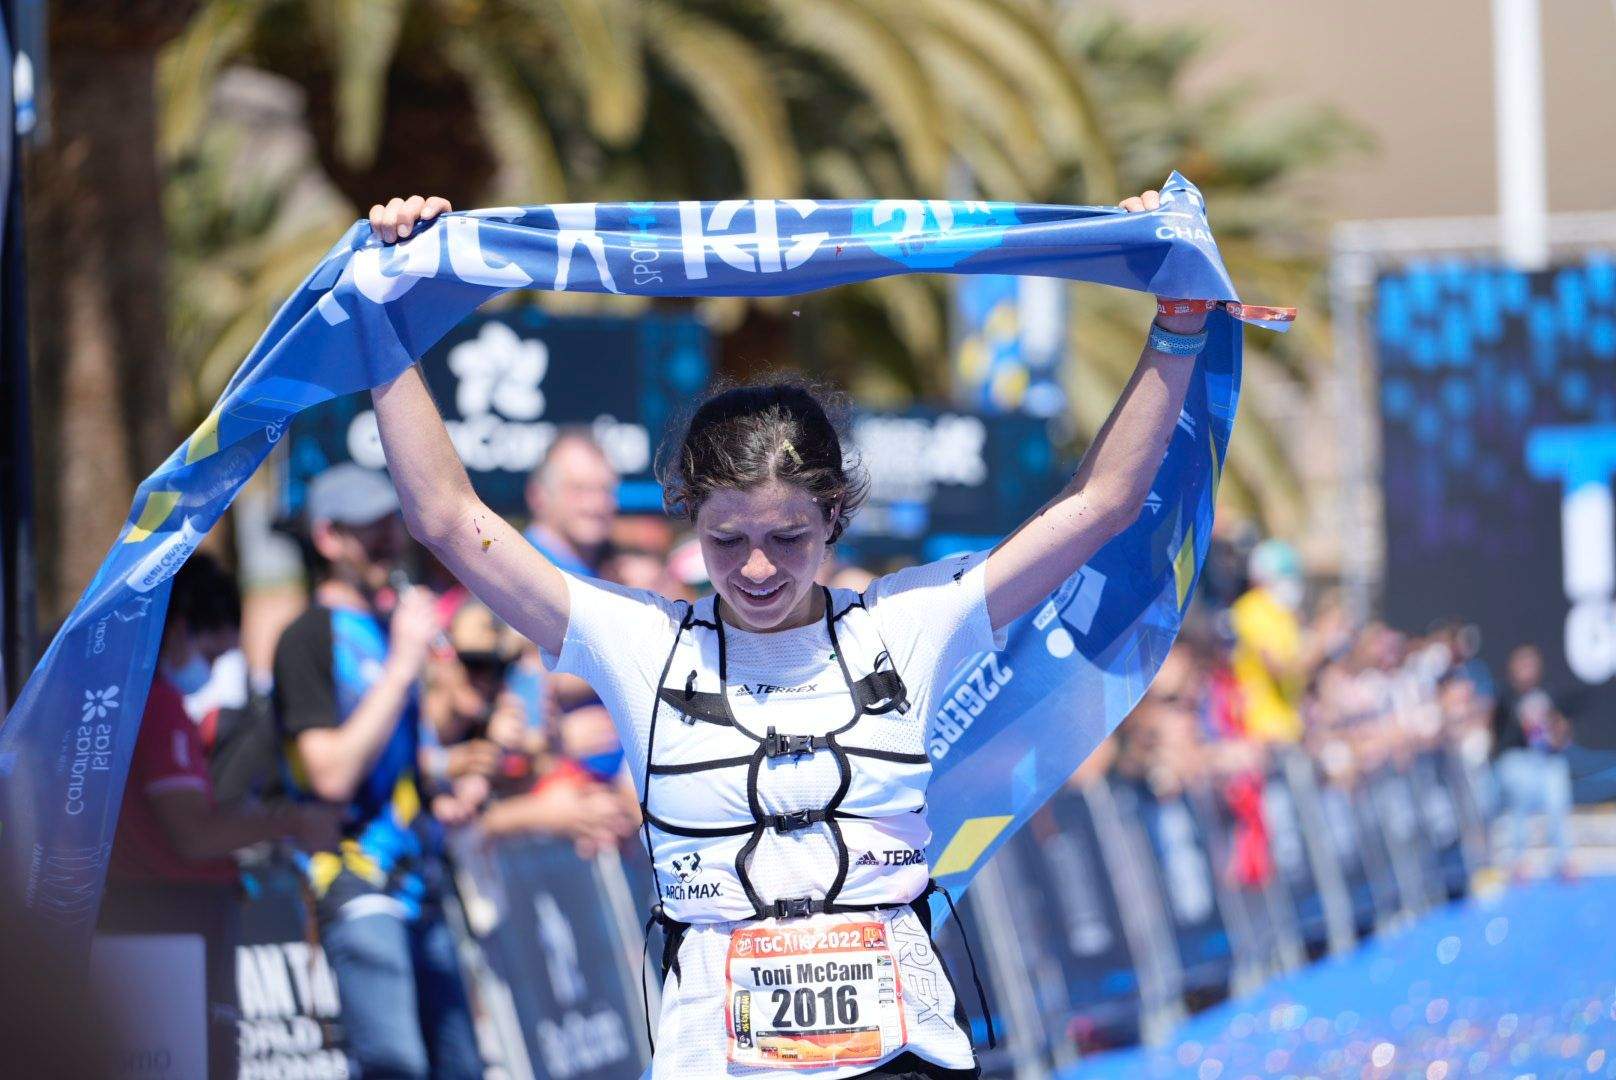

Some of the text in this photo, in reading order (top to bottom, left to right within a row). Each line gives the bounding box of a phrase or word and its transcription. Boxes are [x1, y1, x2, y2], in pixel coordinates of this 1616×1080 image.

[757, 683, 819, 694] TERREX
[688, 883, 721, 899] MAX
[818, 929, 861, 949] 2022
[751, 961, 873, 988] Toni McCann
[771, 985, 859, 1029] 2016
